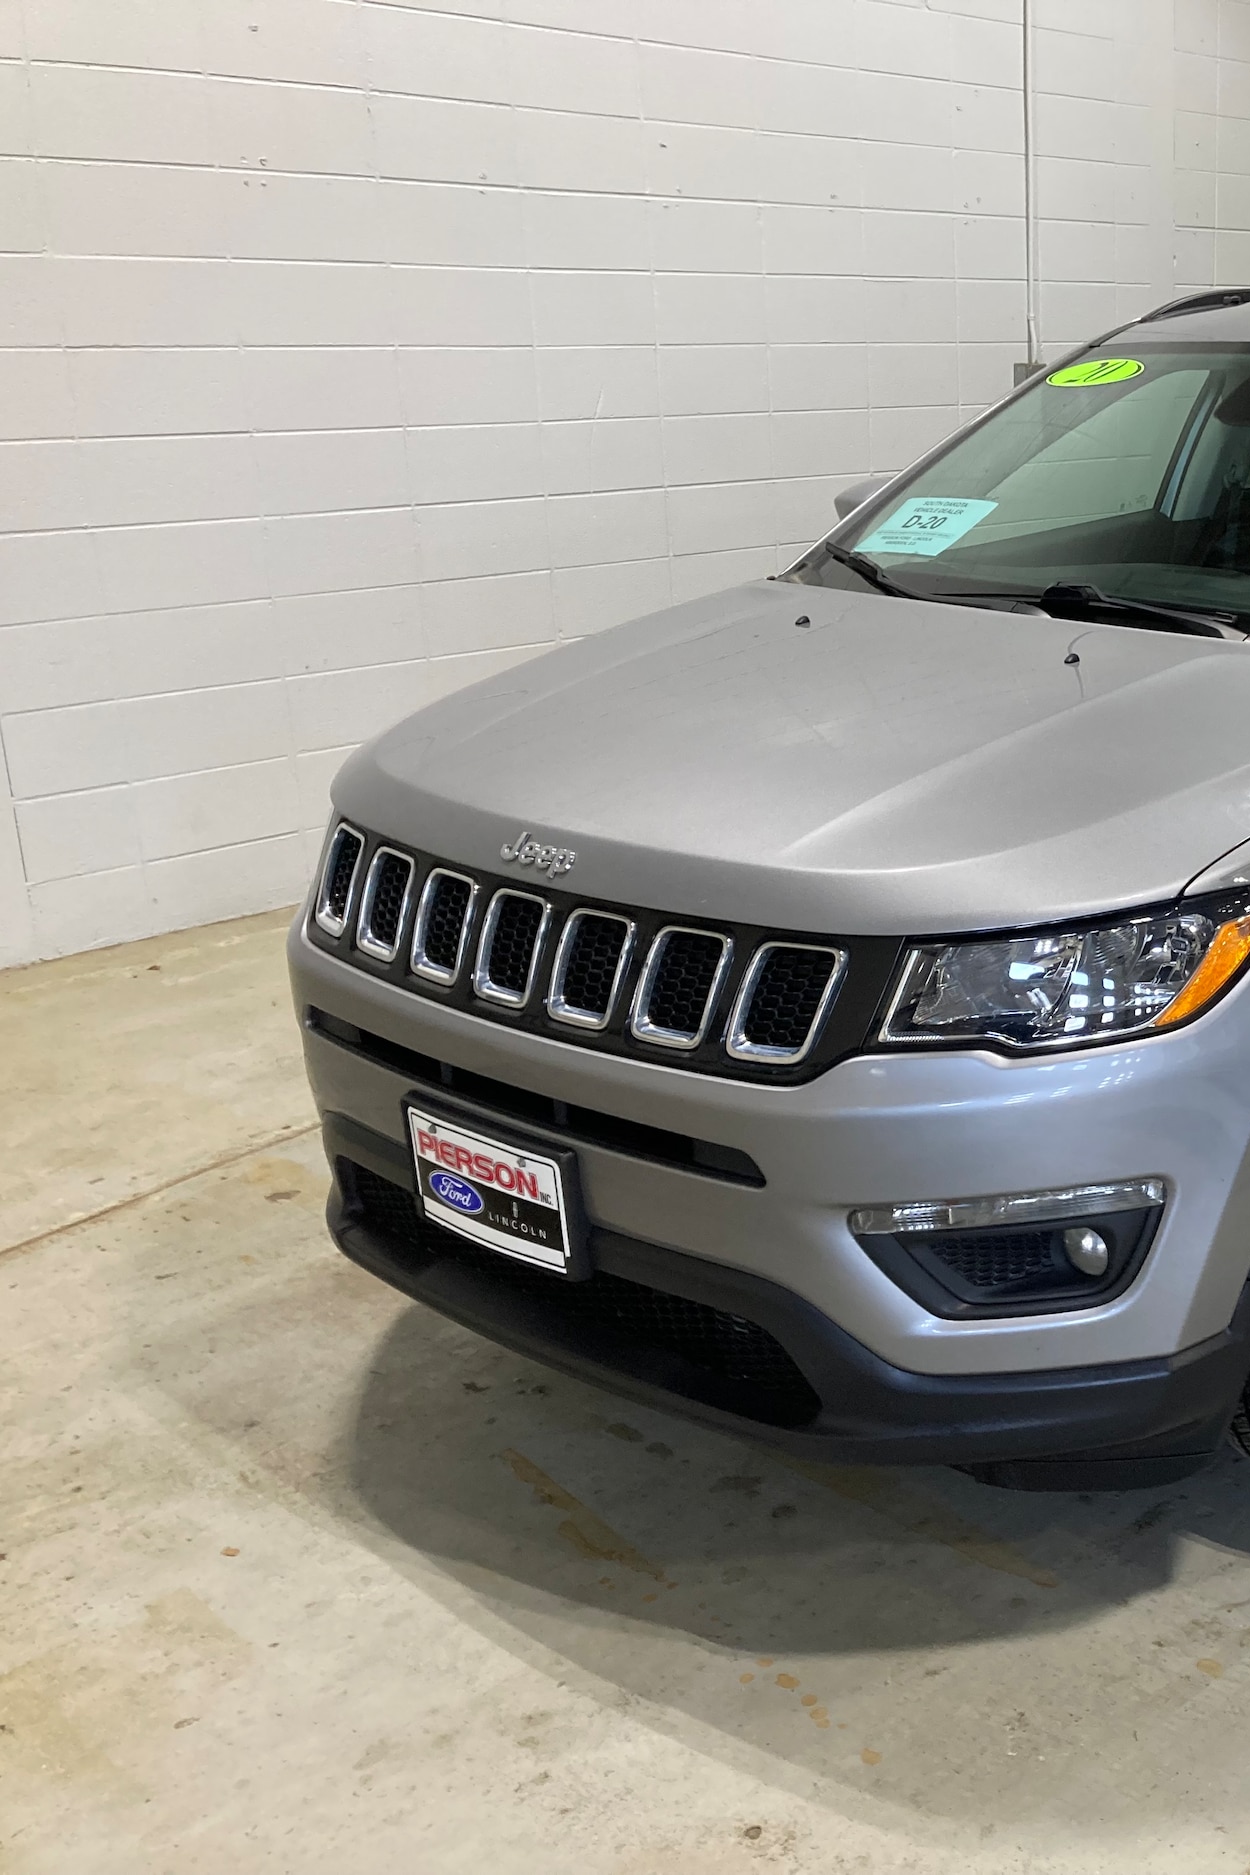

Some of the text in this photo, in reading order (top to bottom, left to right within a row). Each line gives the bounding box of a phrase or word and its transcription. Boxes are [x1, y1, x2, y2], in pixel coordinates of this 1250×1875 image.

[901, 515, 948, 530] D-20
[500, 831, 576, 879] Jeep
[416, 1128, 554, 1206] PIERSON INC.
[439, 1176, 472, 1207] Ford
[488, 1211, 548, 1239] LINCOLN
